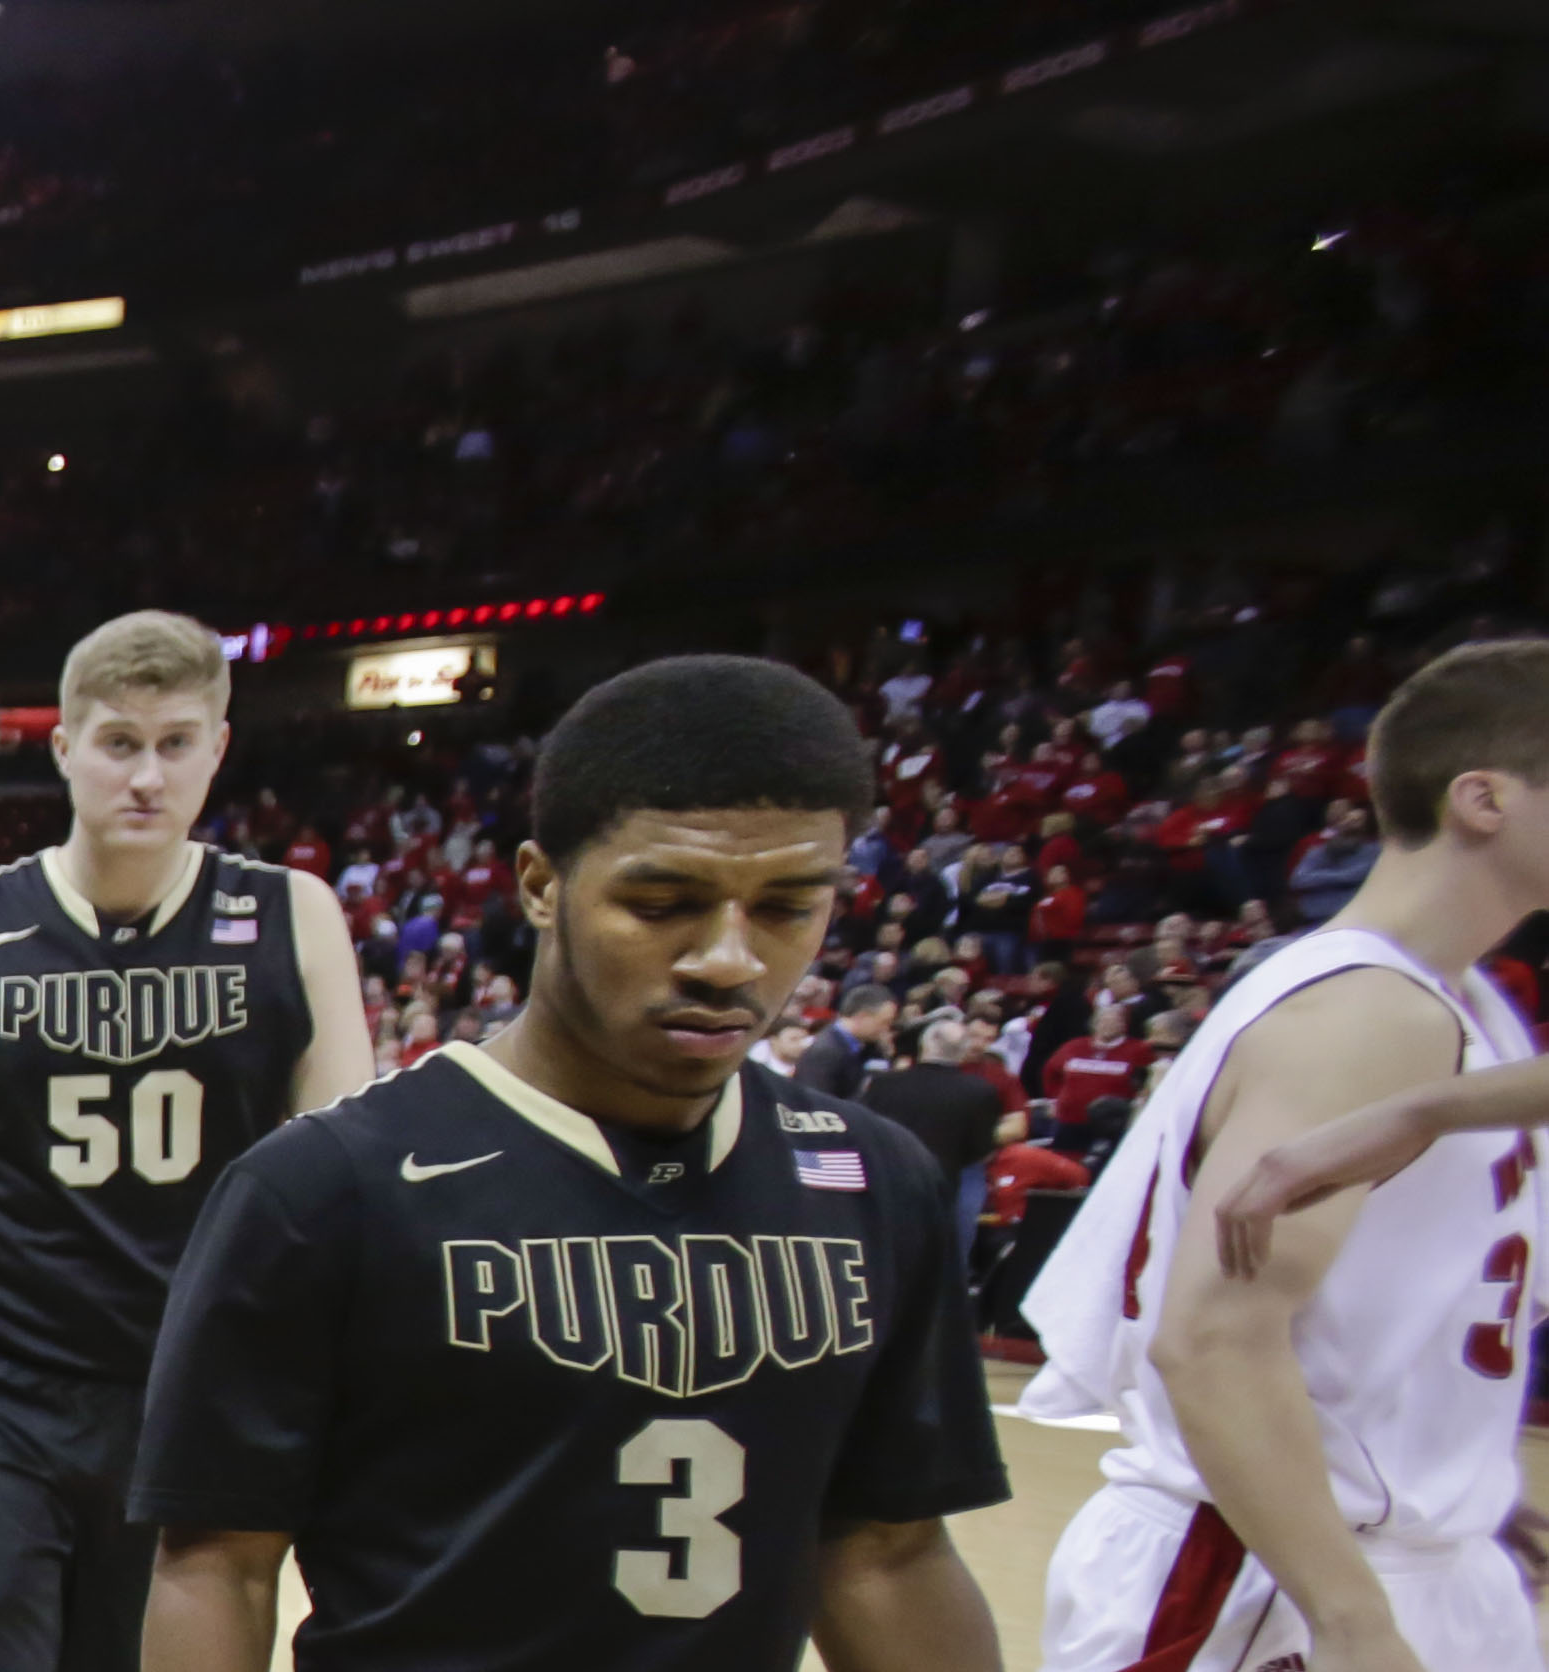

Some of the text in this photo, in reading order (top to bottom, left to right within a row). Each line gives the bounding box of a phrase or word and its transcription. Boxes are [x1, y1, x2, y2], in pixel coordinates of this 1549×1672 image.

[0, 965, 248, 1065] PURDUE
[48, 1069, 203, 1188] 50
[441, 1234, 874, 1398] PURDUE
[610, 1417, 747, 1619] 3
